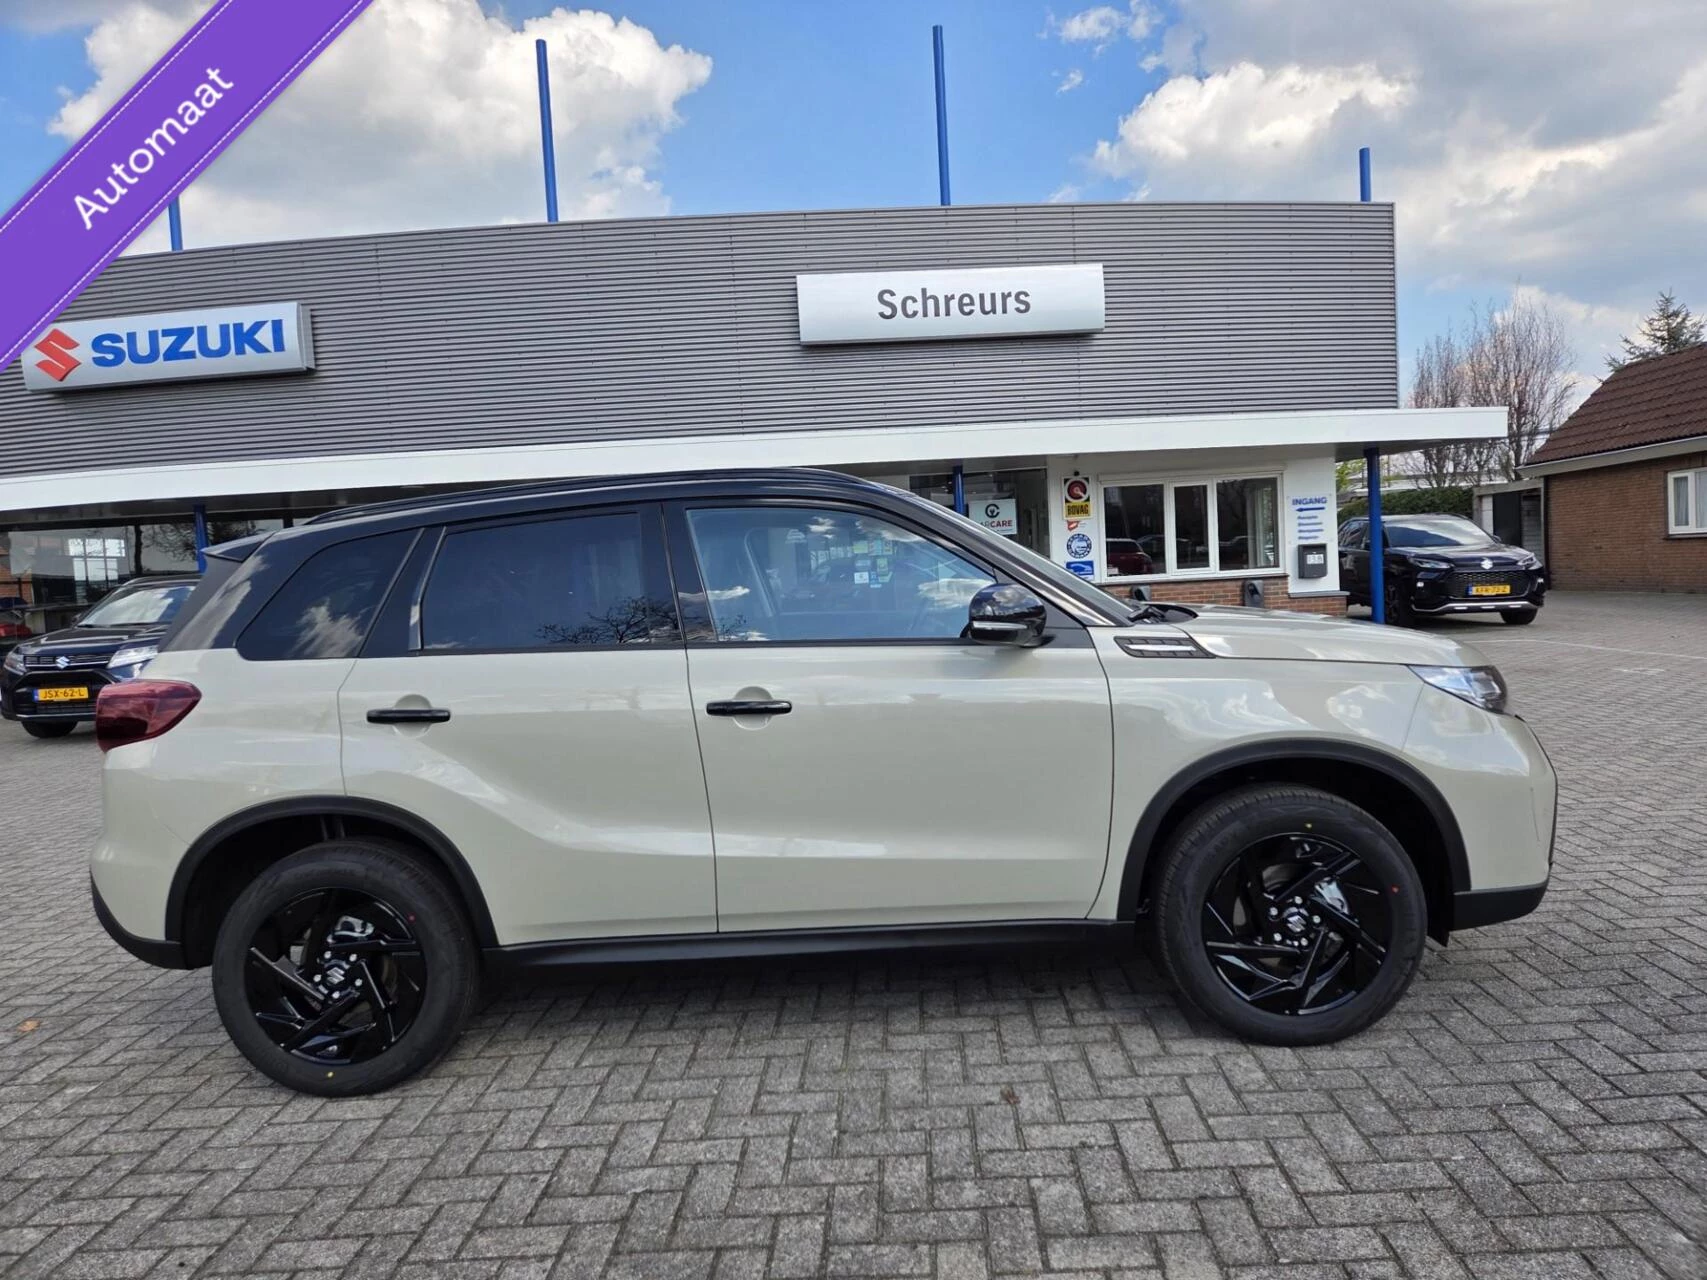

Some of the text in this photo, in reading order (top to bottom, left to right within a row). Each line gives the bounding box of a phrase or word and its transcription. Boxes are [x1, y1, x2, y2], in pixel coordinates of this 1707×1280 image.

[877, 287, 1031, 320] Schreurs
[91, 319, 286, 367] SUZUKI
[1292, 497, 1327, 505] INGANG
[1067, 503, 1089, 516] BOVAG
[43, 688, 85, 698] JSX-62-L
